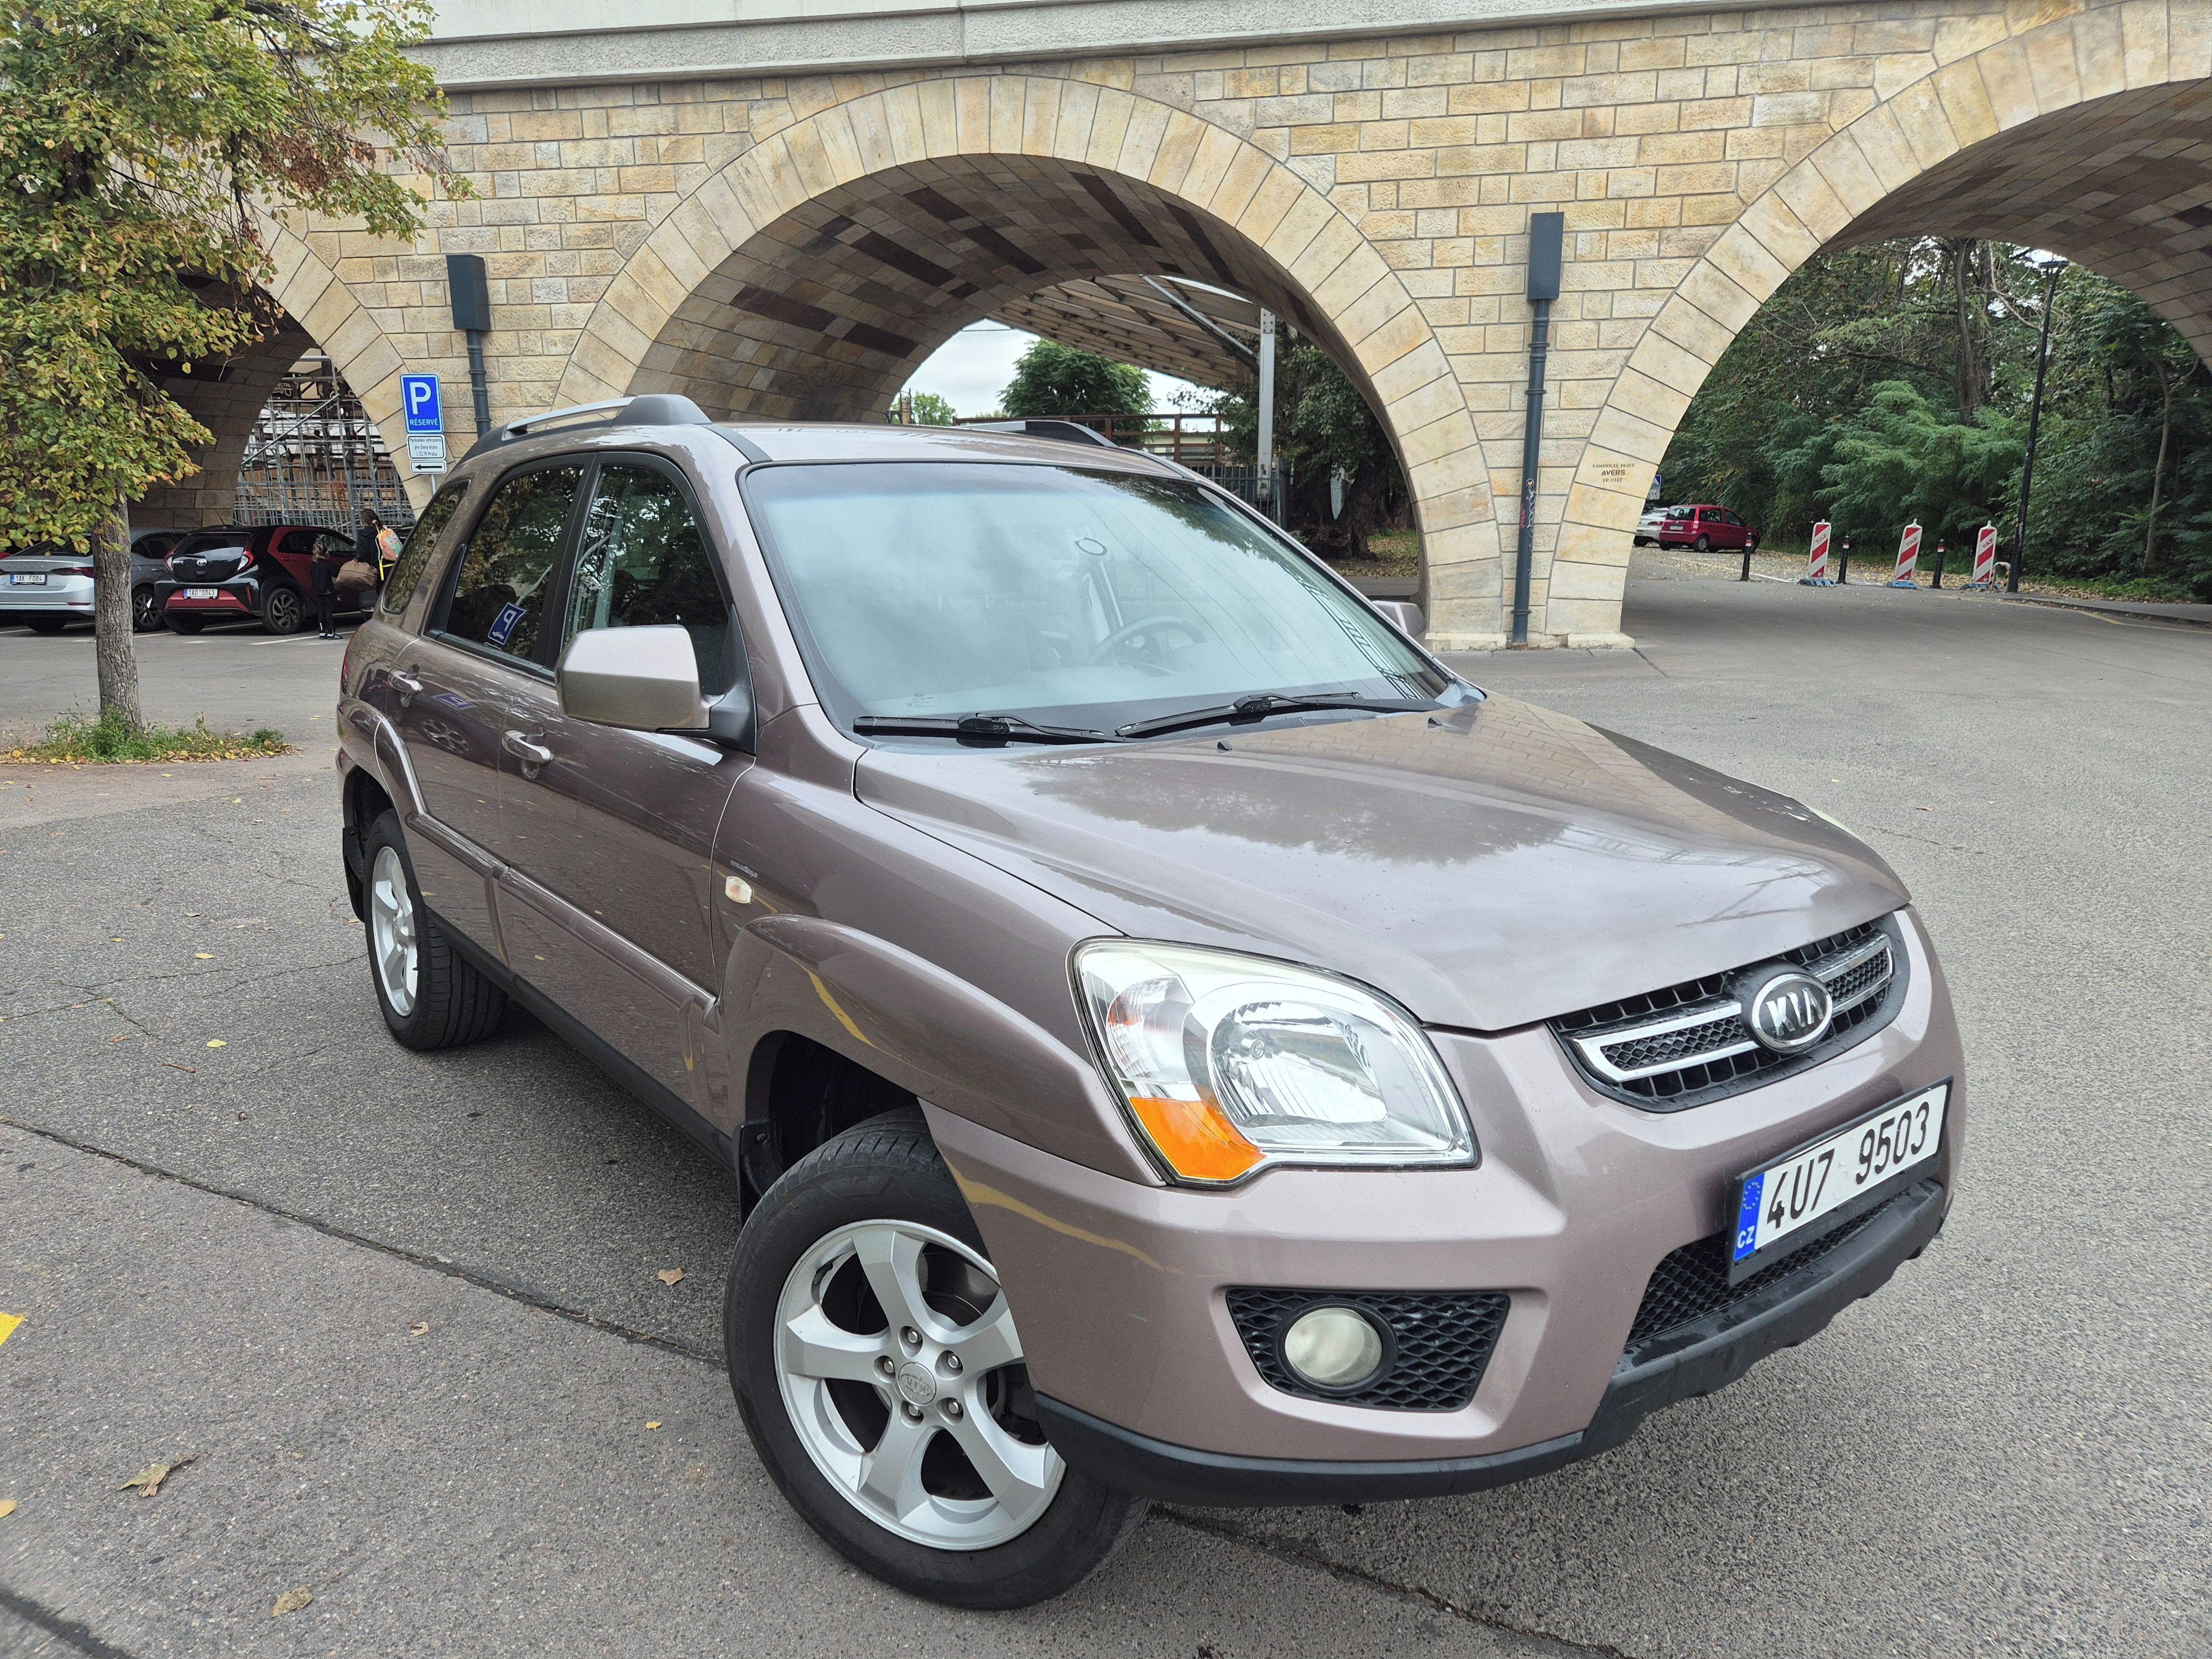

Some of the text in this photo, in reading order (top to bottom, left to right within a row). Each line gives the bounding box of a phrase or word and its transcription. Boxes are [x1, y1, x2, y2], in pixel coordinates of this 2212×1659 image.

[410, 382, 431, 414] P
[410, 418, 439, 426] RÉSERVÉ
[1766, 1101, 1930, 1229] 4U7 9503
[1738, 1225, 1755, 1249] CZ
